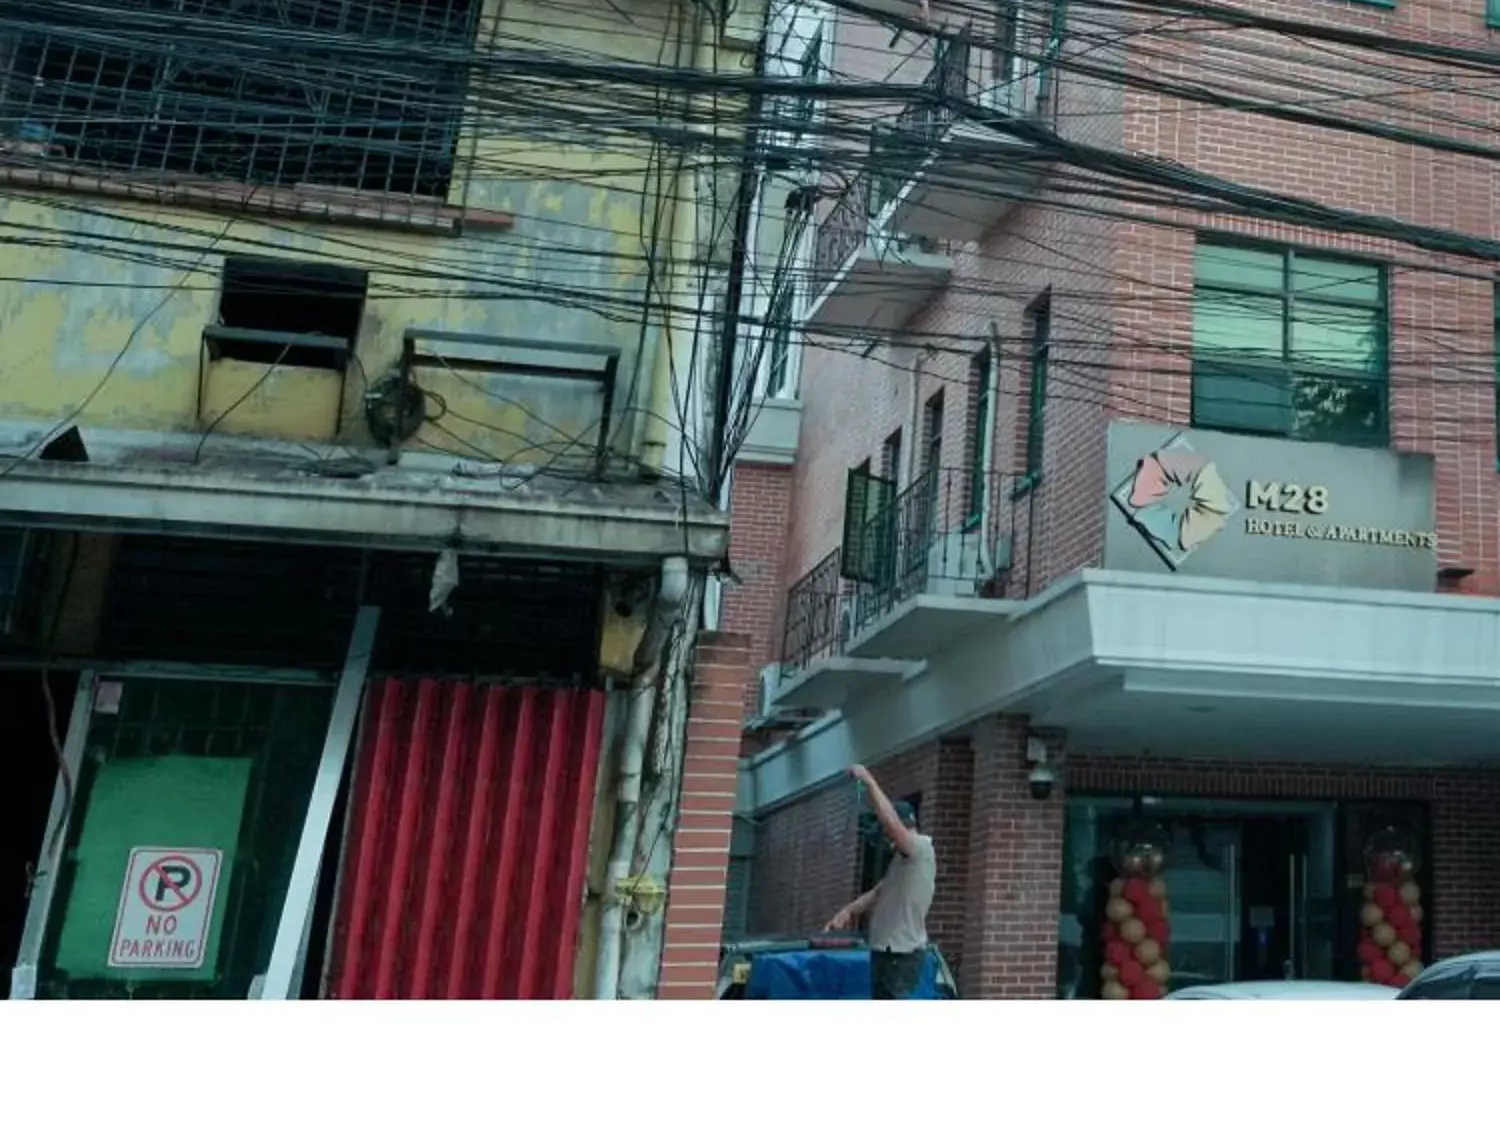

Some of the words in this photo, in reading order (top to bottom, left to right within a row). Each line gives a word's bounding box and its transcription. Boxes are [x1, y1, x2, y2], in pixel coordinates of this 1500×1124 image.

[1245, 479, 1329, 515] M28
[1246, 517, 1301, 539] HOTEL
[1305, 525, 1321, 540] &
[1323, 523, 1437, 549] APARTMENTS
[145, 914, 178, 936] NO
[119, 939, 196, 959] PARKING
